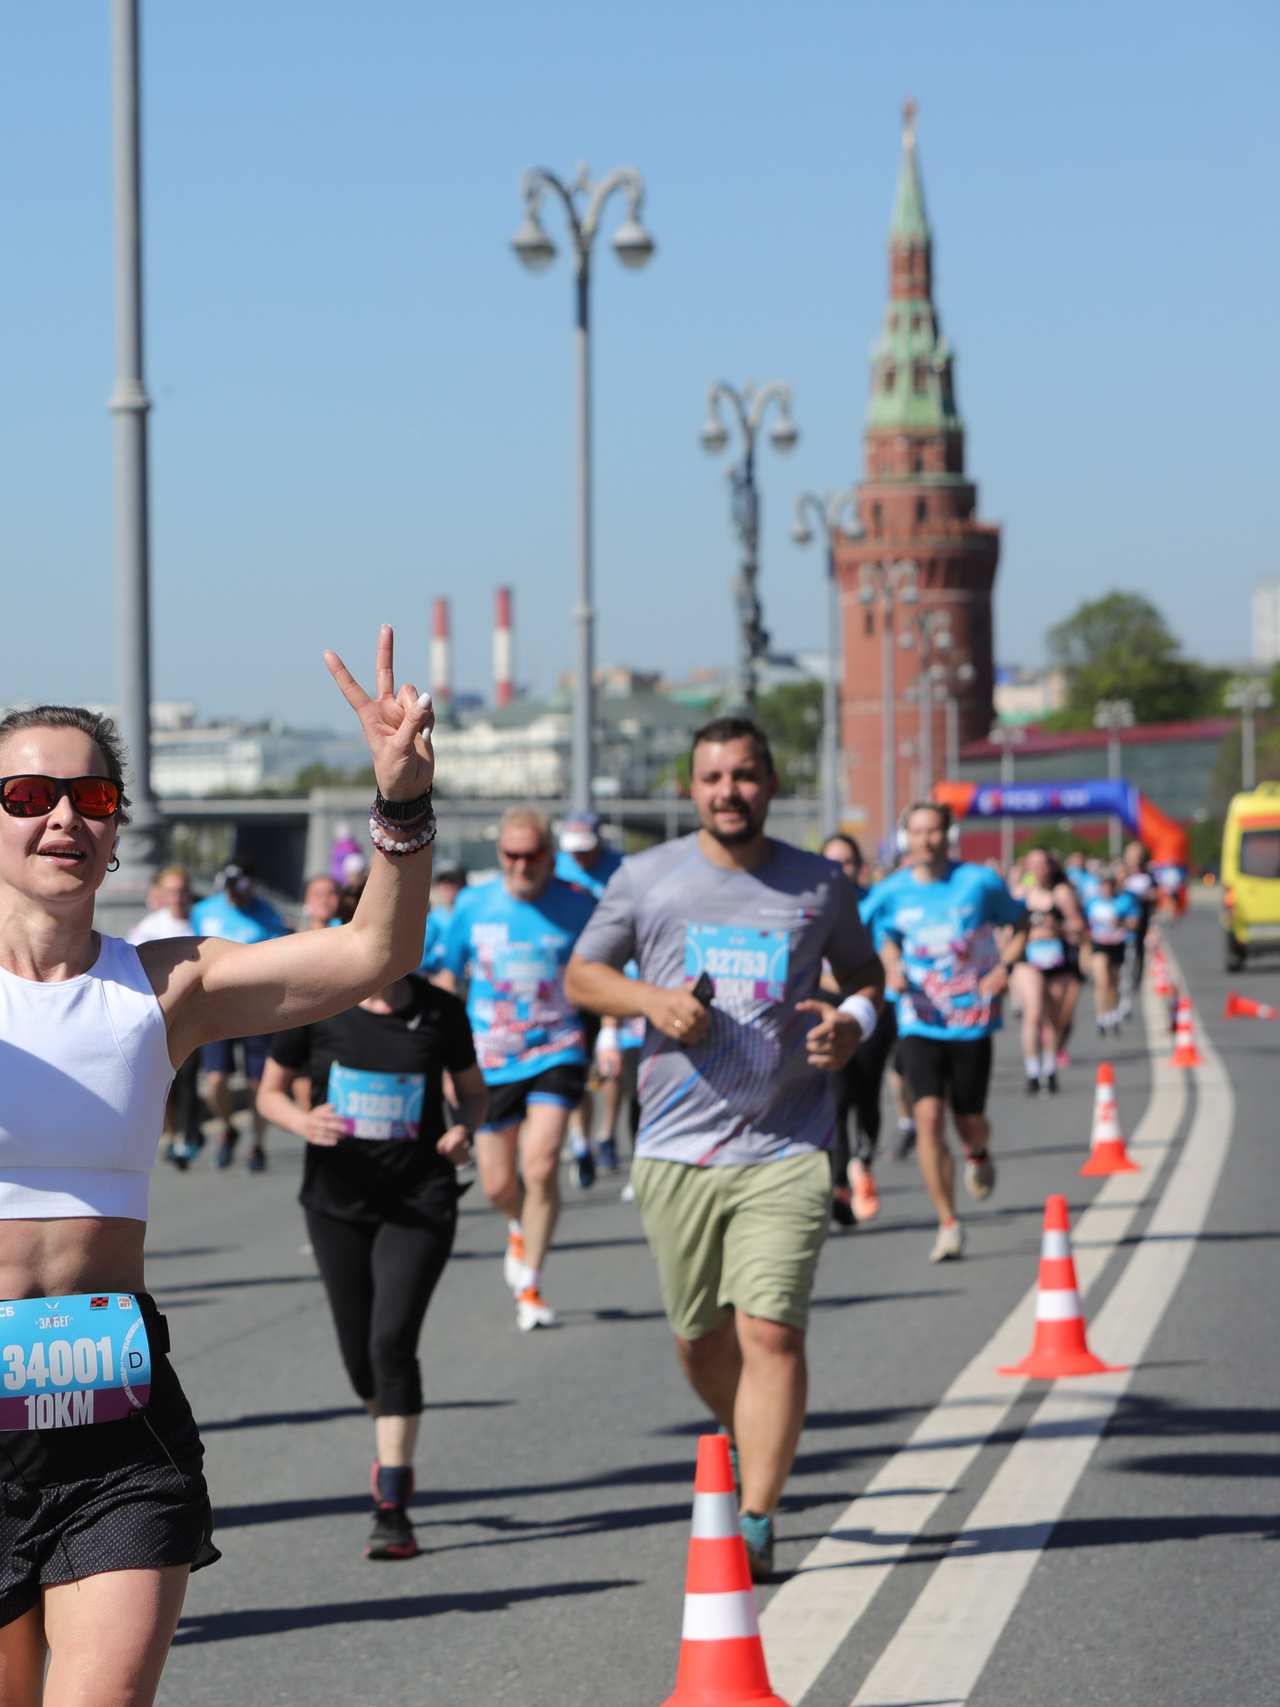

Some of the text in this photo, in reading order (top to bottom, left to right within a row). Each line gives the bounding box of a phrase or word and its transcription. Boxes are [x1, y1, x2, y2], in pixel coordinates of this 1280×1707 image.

[704, 947, 767, 977] 32753
[2, 1336, 114, 1391] 34001
[128, 1351, 144, 1369] D
